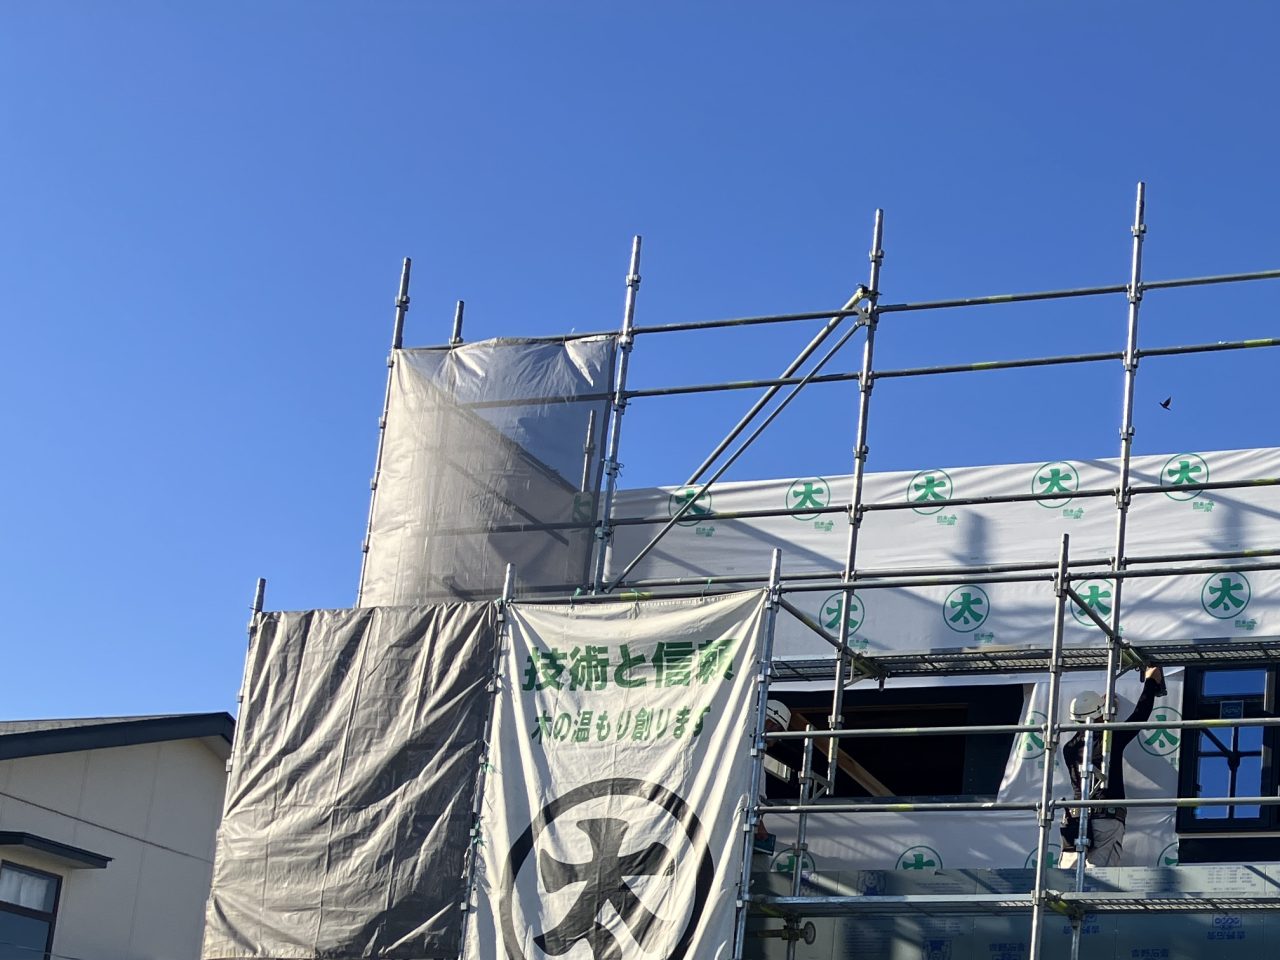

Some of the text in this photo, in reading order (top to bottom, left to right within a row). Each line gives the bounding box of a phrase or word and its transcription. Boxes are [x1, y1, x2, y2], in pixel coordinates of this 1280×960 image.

[950, 593, 984, 625] 太
[1208, 578, 1246, 611] 太
[522, 638, 740, 692] 技術と信頼
[531, 705, 711, 745] 木の温もり創ります
